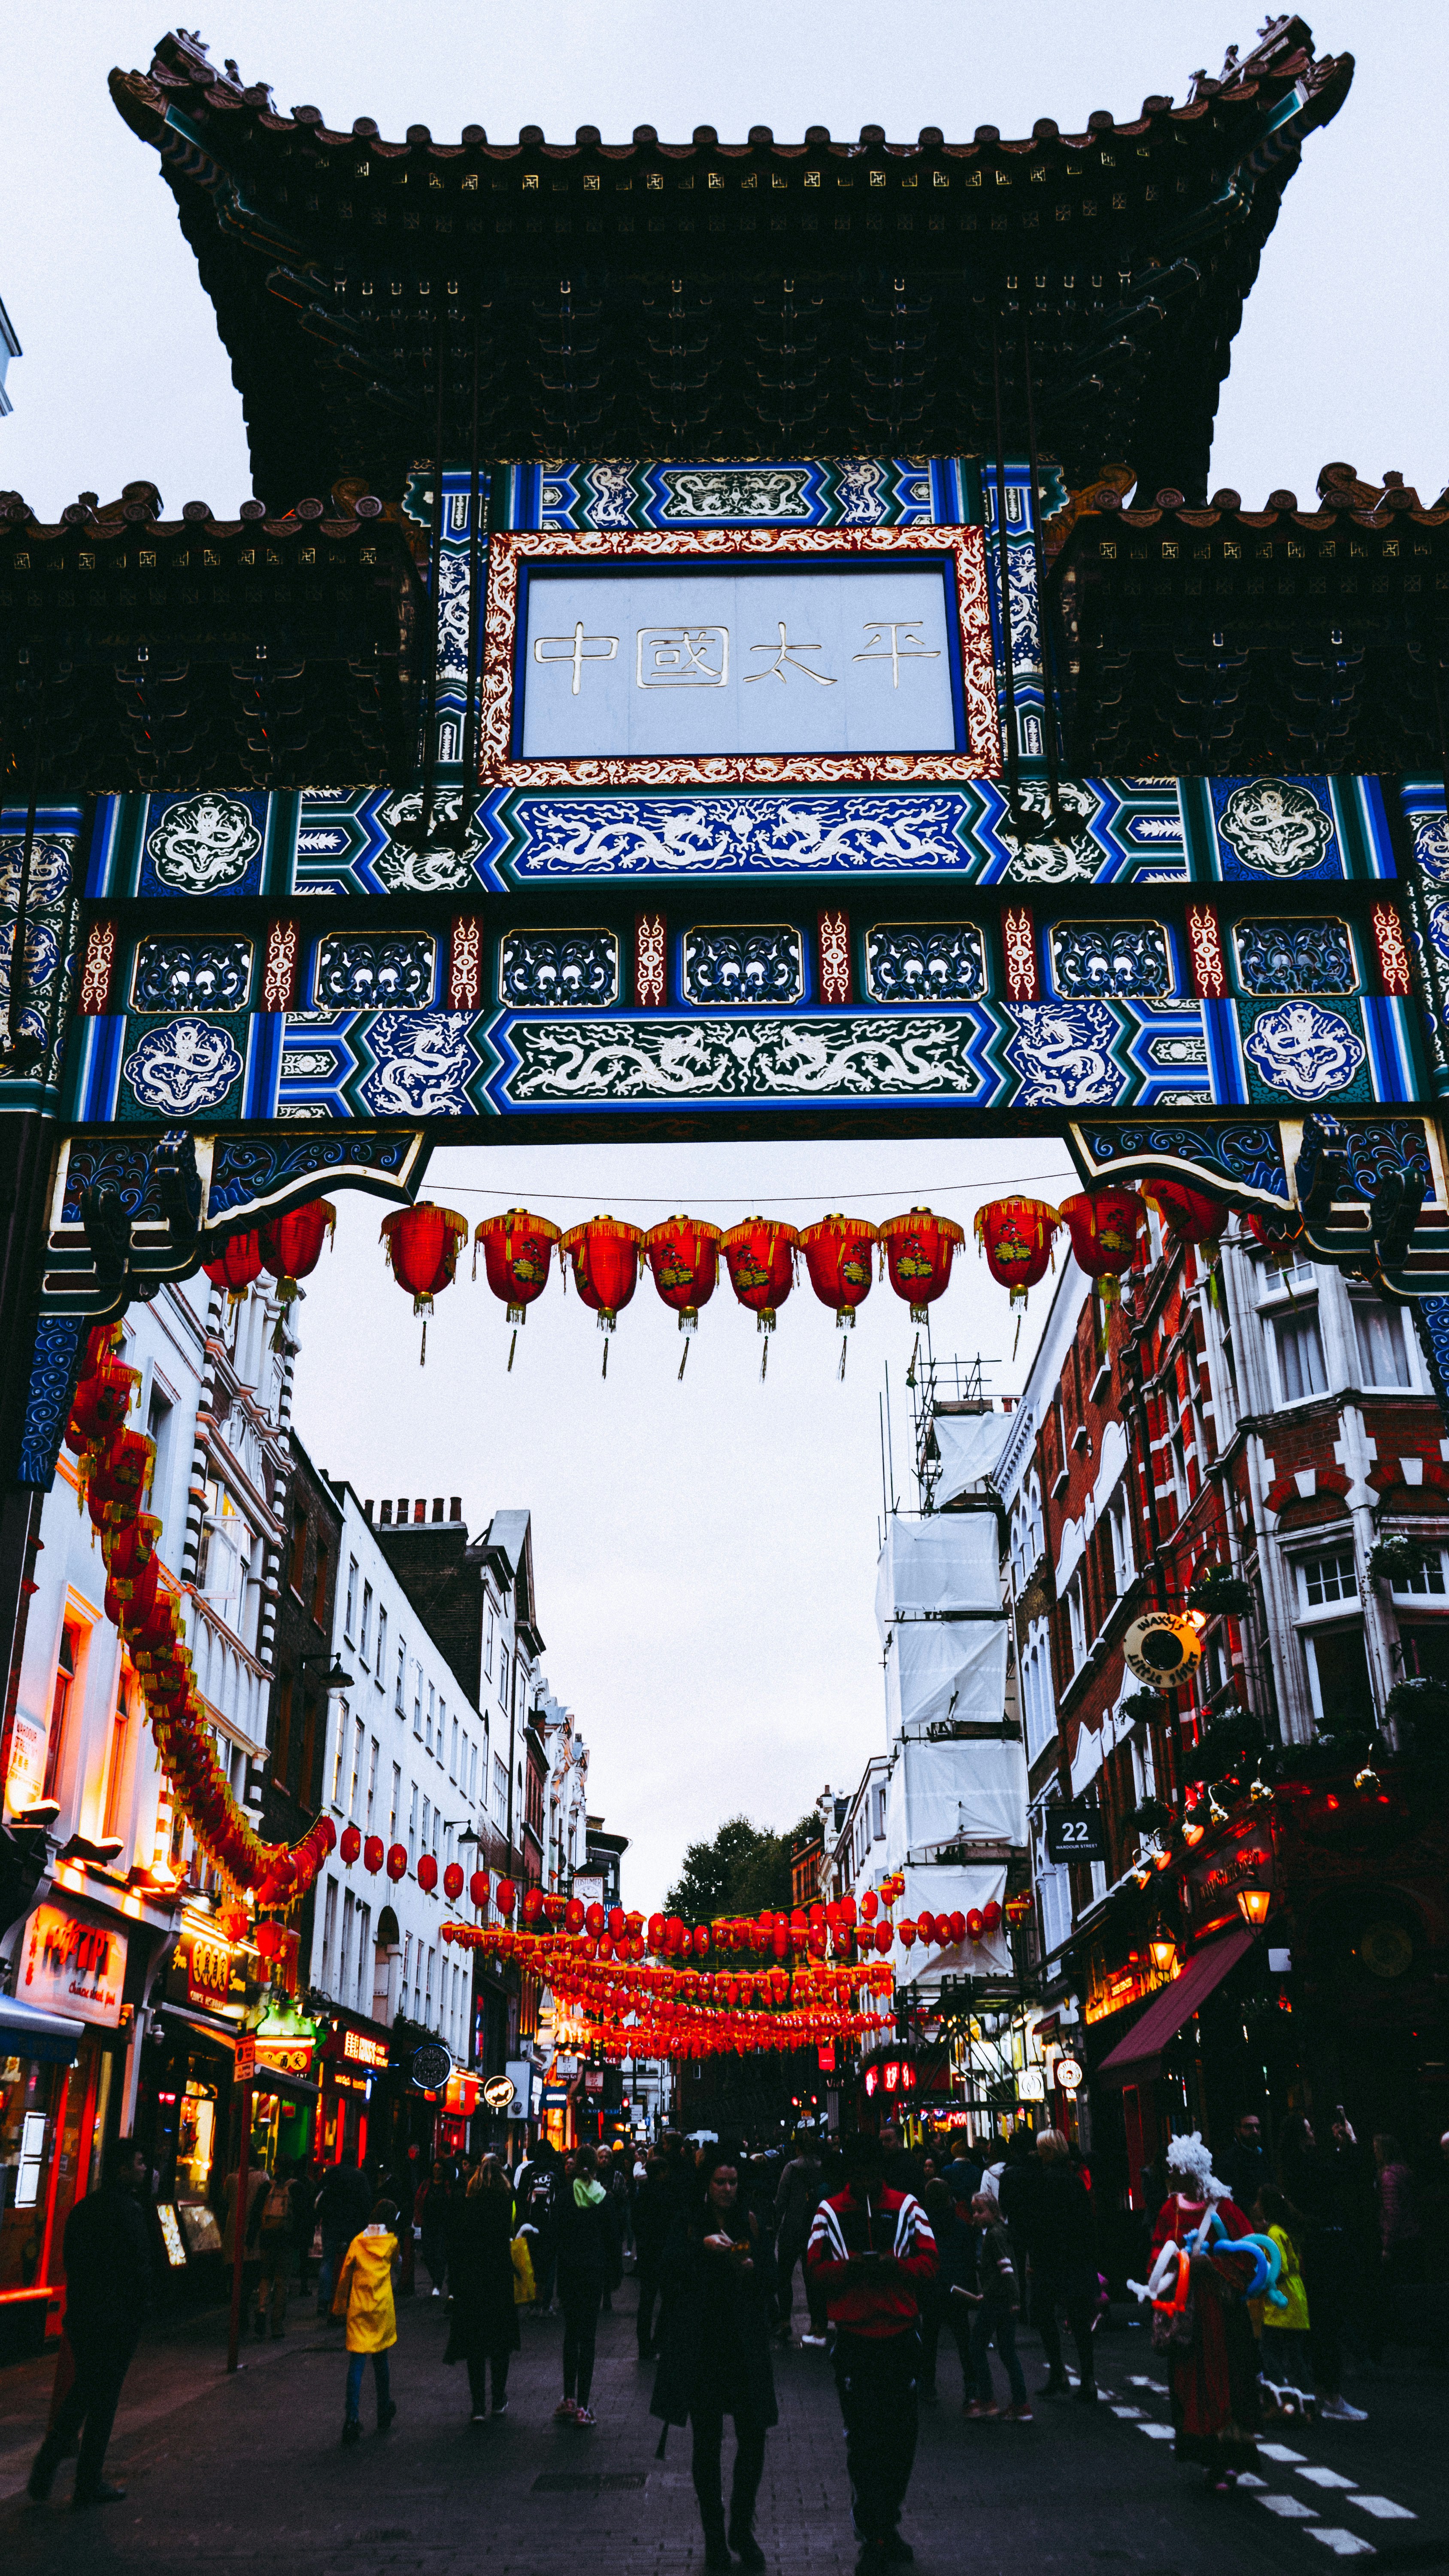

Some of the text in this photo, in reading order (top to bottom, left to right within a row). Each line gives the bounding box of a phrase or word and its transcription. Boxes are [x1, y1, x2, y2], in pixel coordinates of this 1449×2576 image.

[534, 621, 941, 696] 中國太平
[1062, 1822, 1089, 1841] 22
